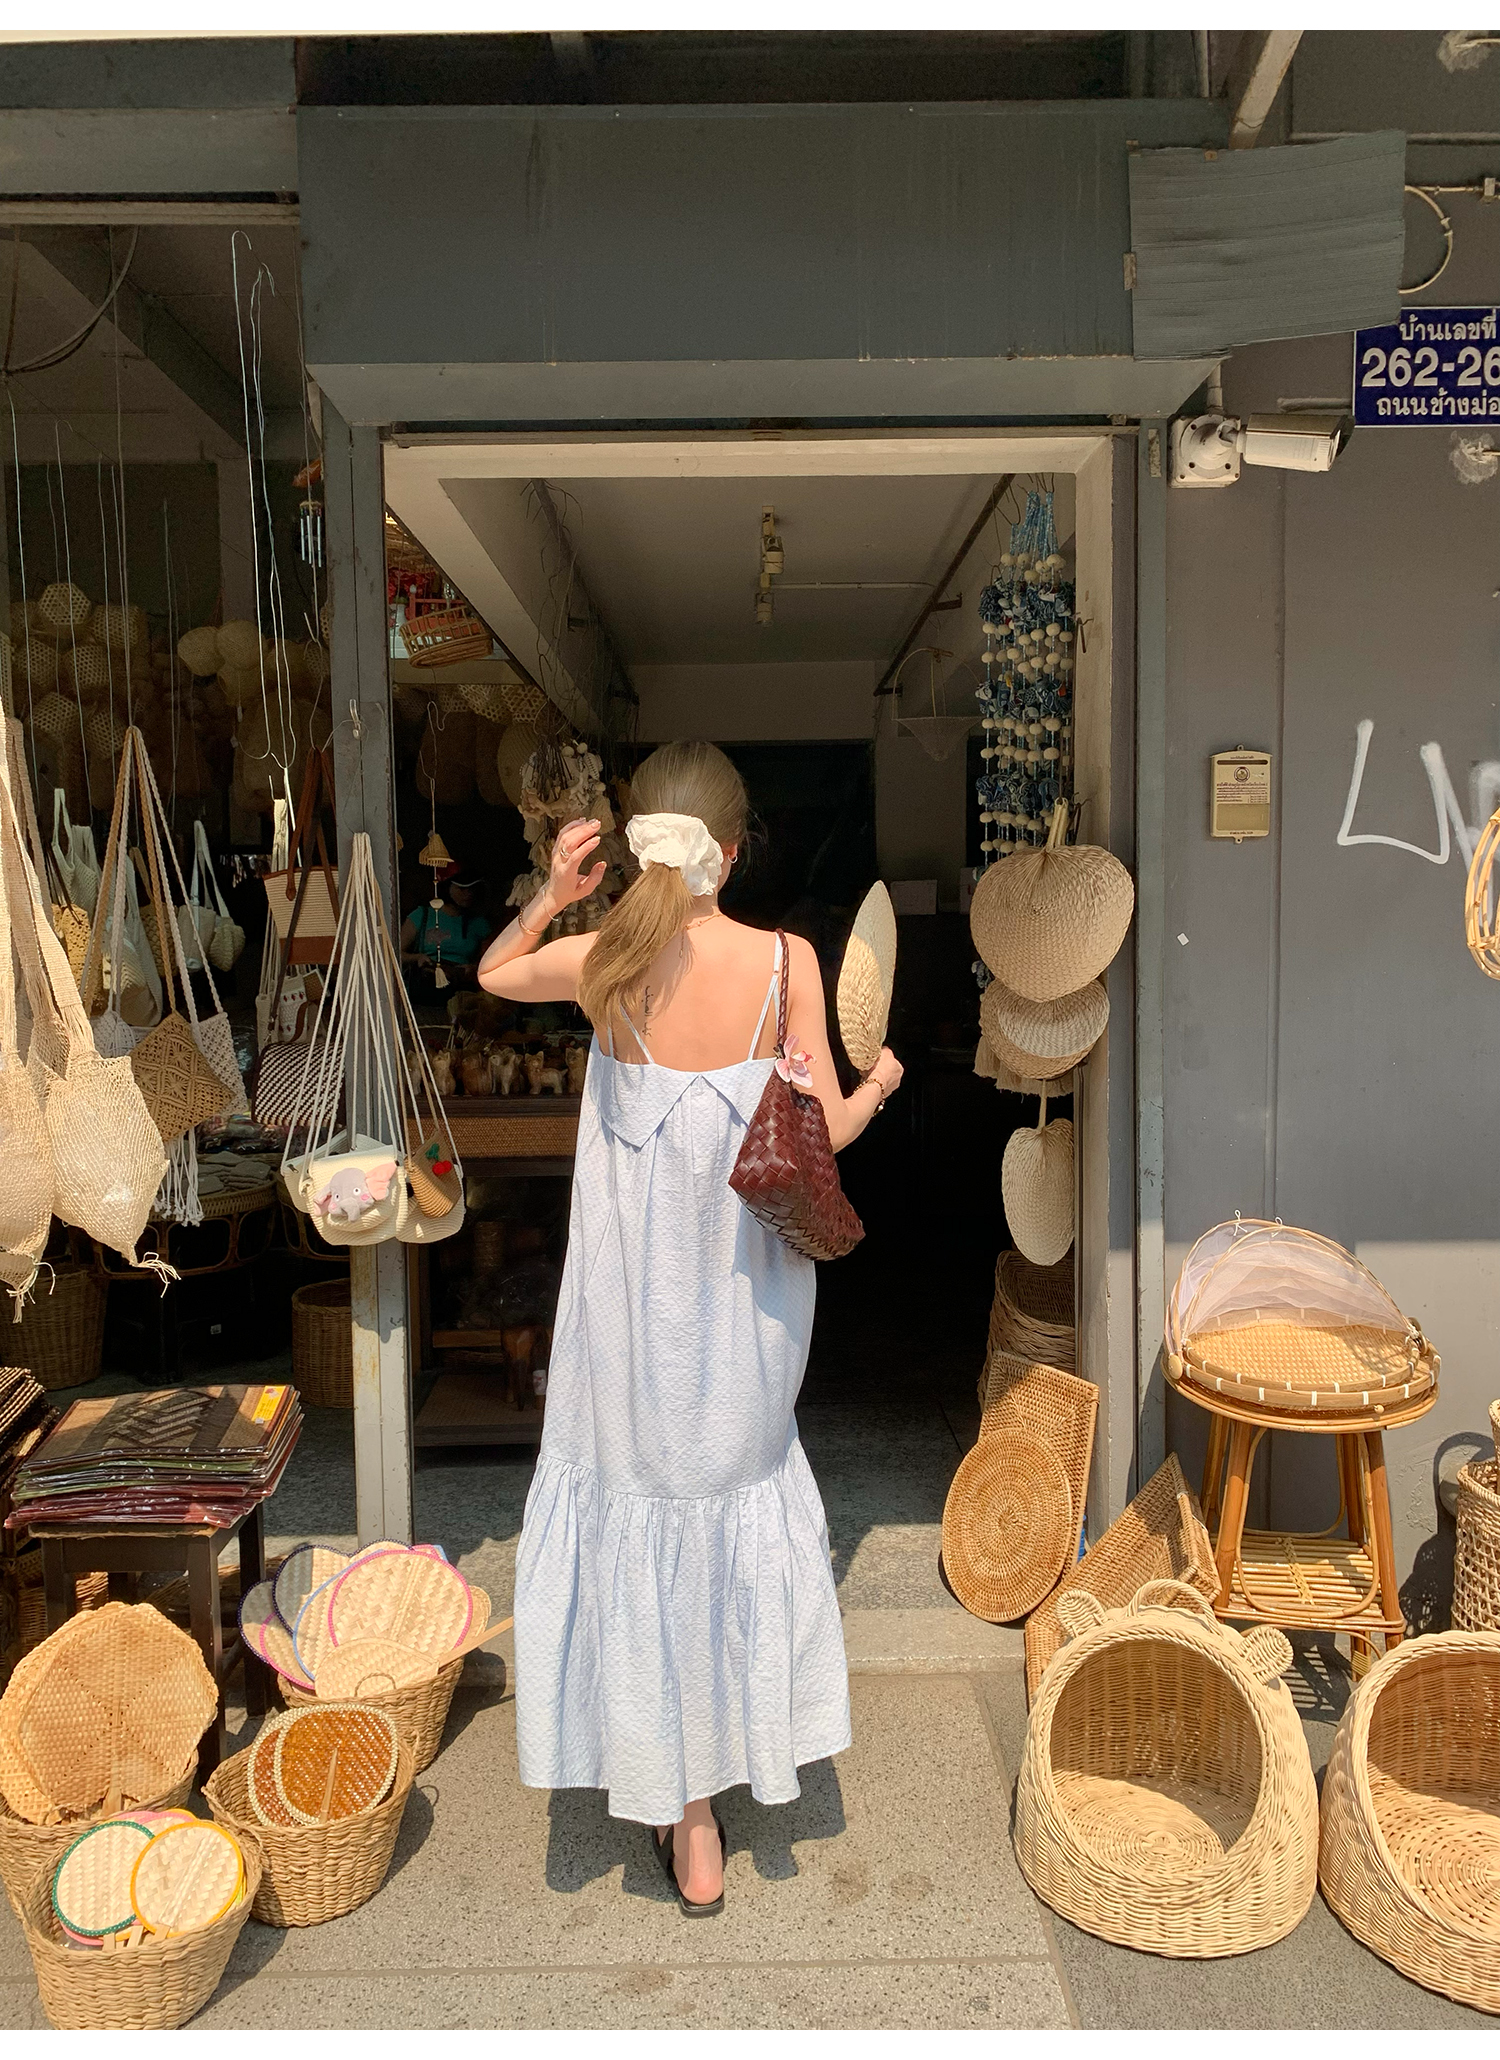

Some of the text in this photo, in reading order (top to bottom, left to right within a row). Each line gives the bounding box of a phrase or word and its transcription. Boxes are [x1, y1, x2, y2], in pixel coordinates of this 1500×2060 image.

[1399, 308, 1497, 341] บ้านเลขที่
[1361, 346, 1500, 387] 262-26
